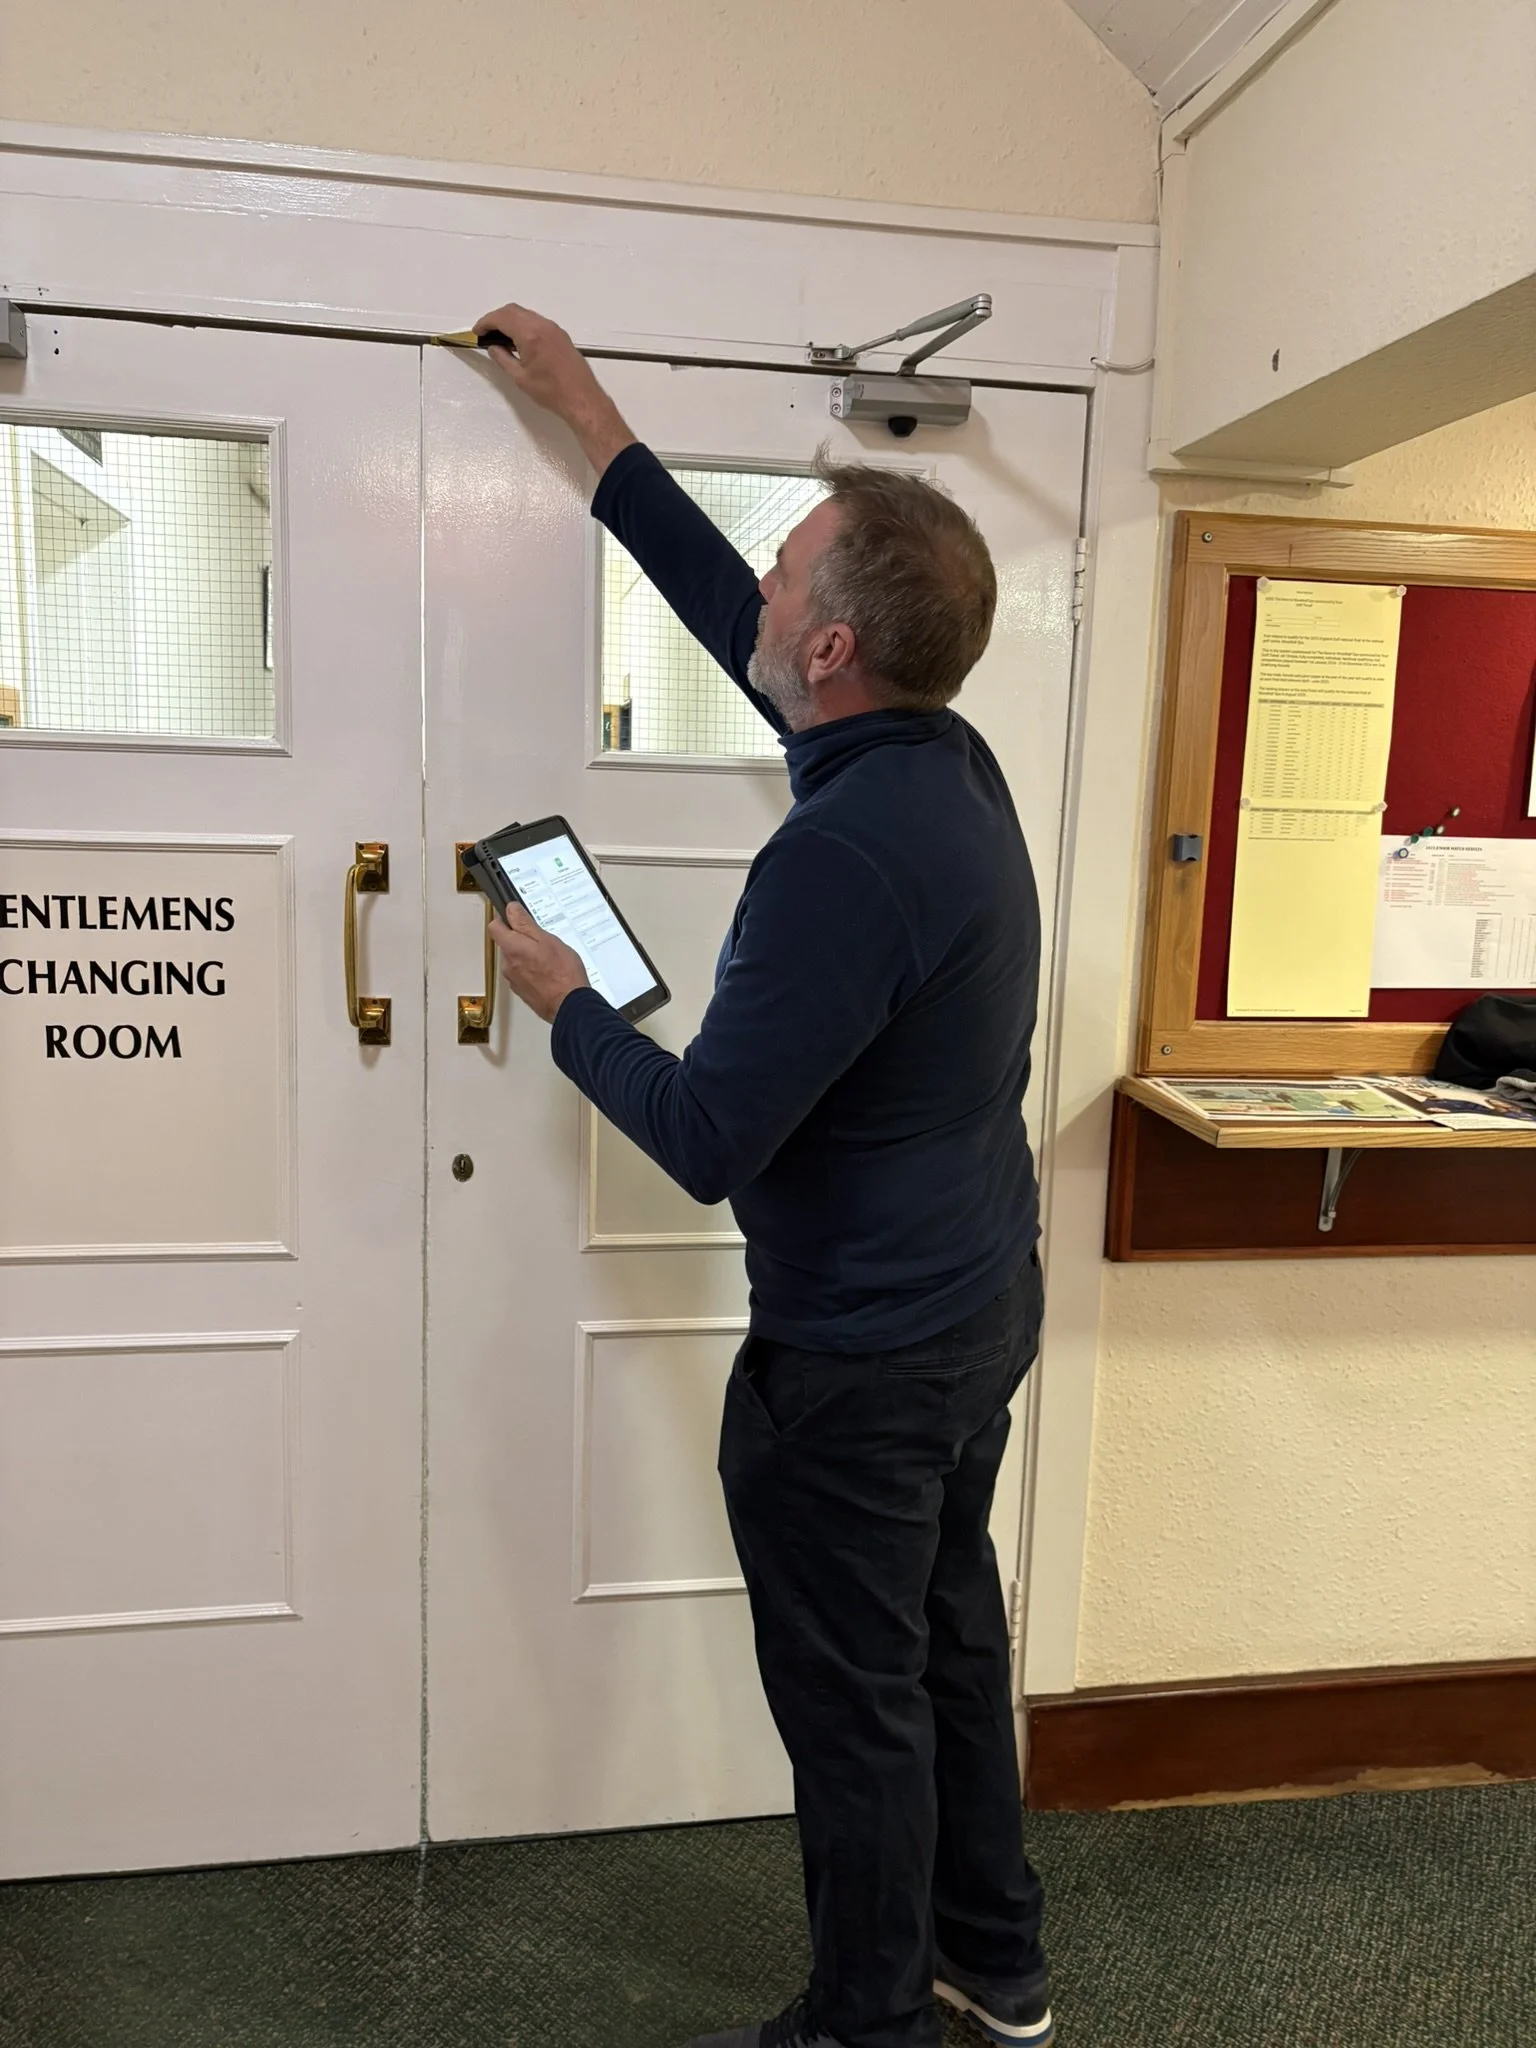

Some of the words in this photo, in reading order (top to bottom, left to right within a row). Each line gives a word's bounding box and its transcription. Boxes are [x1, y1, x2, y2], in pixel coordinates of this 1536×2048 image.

[0, 894, 235, 932] ENTLEMENS
[0, 958, 226, 996] CHANGING
[45, 1024, 182, 1059] ROOM
